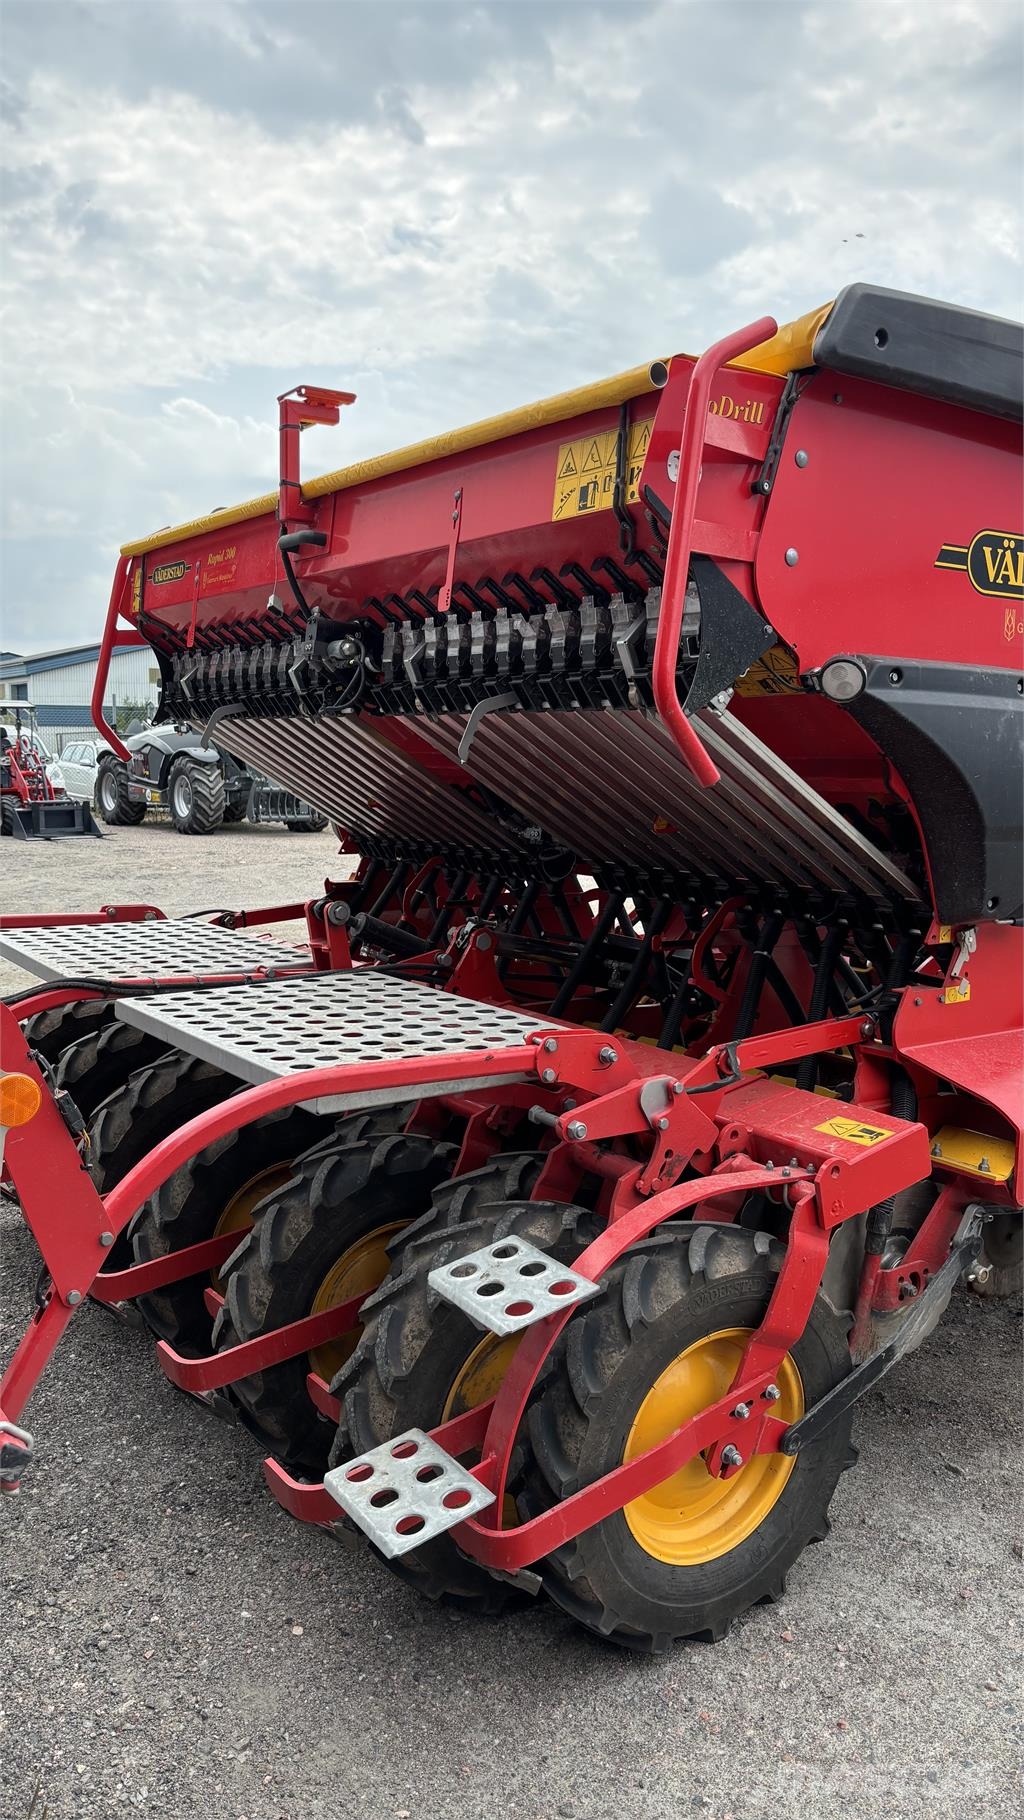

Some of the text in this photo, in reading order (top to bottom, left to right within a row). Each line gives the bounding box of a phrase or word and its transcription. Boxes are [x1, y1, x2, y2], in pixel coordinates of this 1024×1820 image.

[708, 395, 763, 424] oDrill
[208, 547, 236, 566] Rapid 300
[155, 564, 184, 583] VÄDERSTAD
